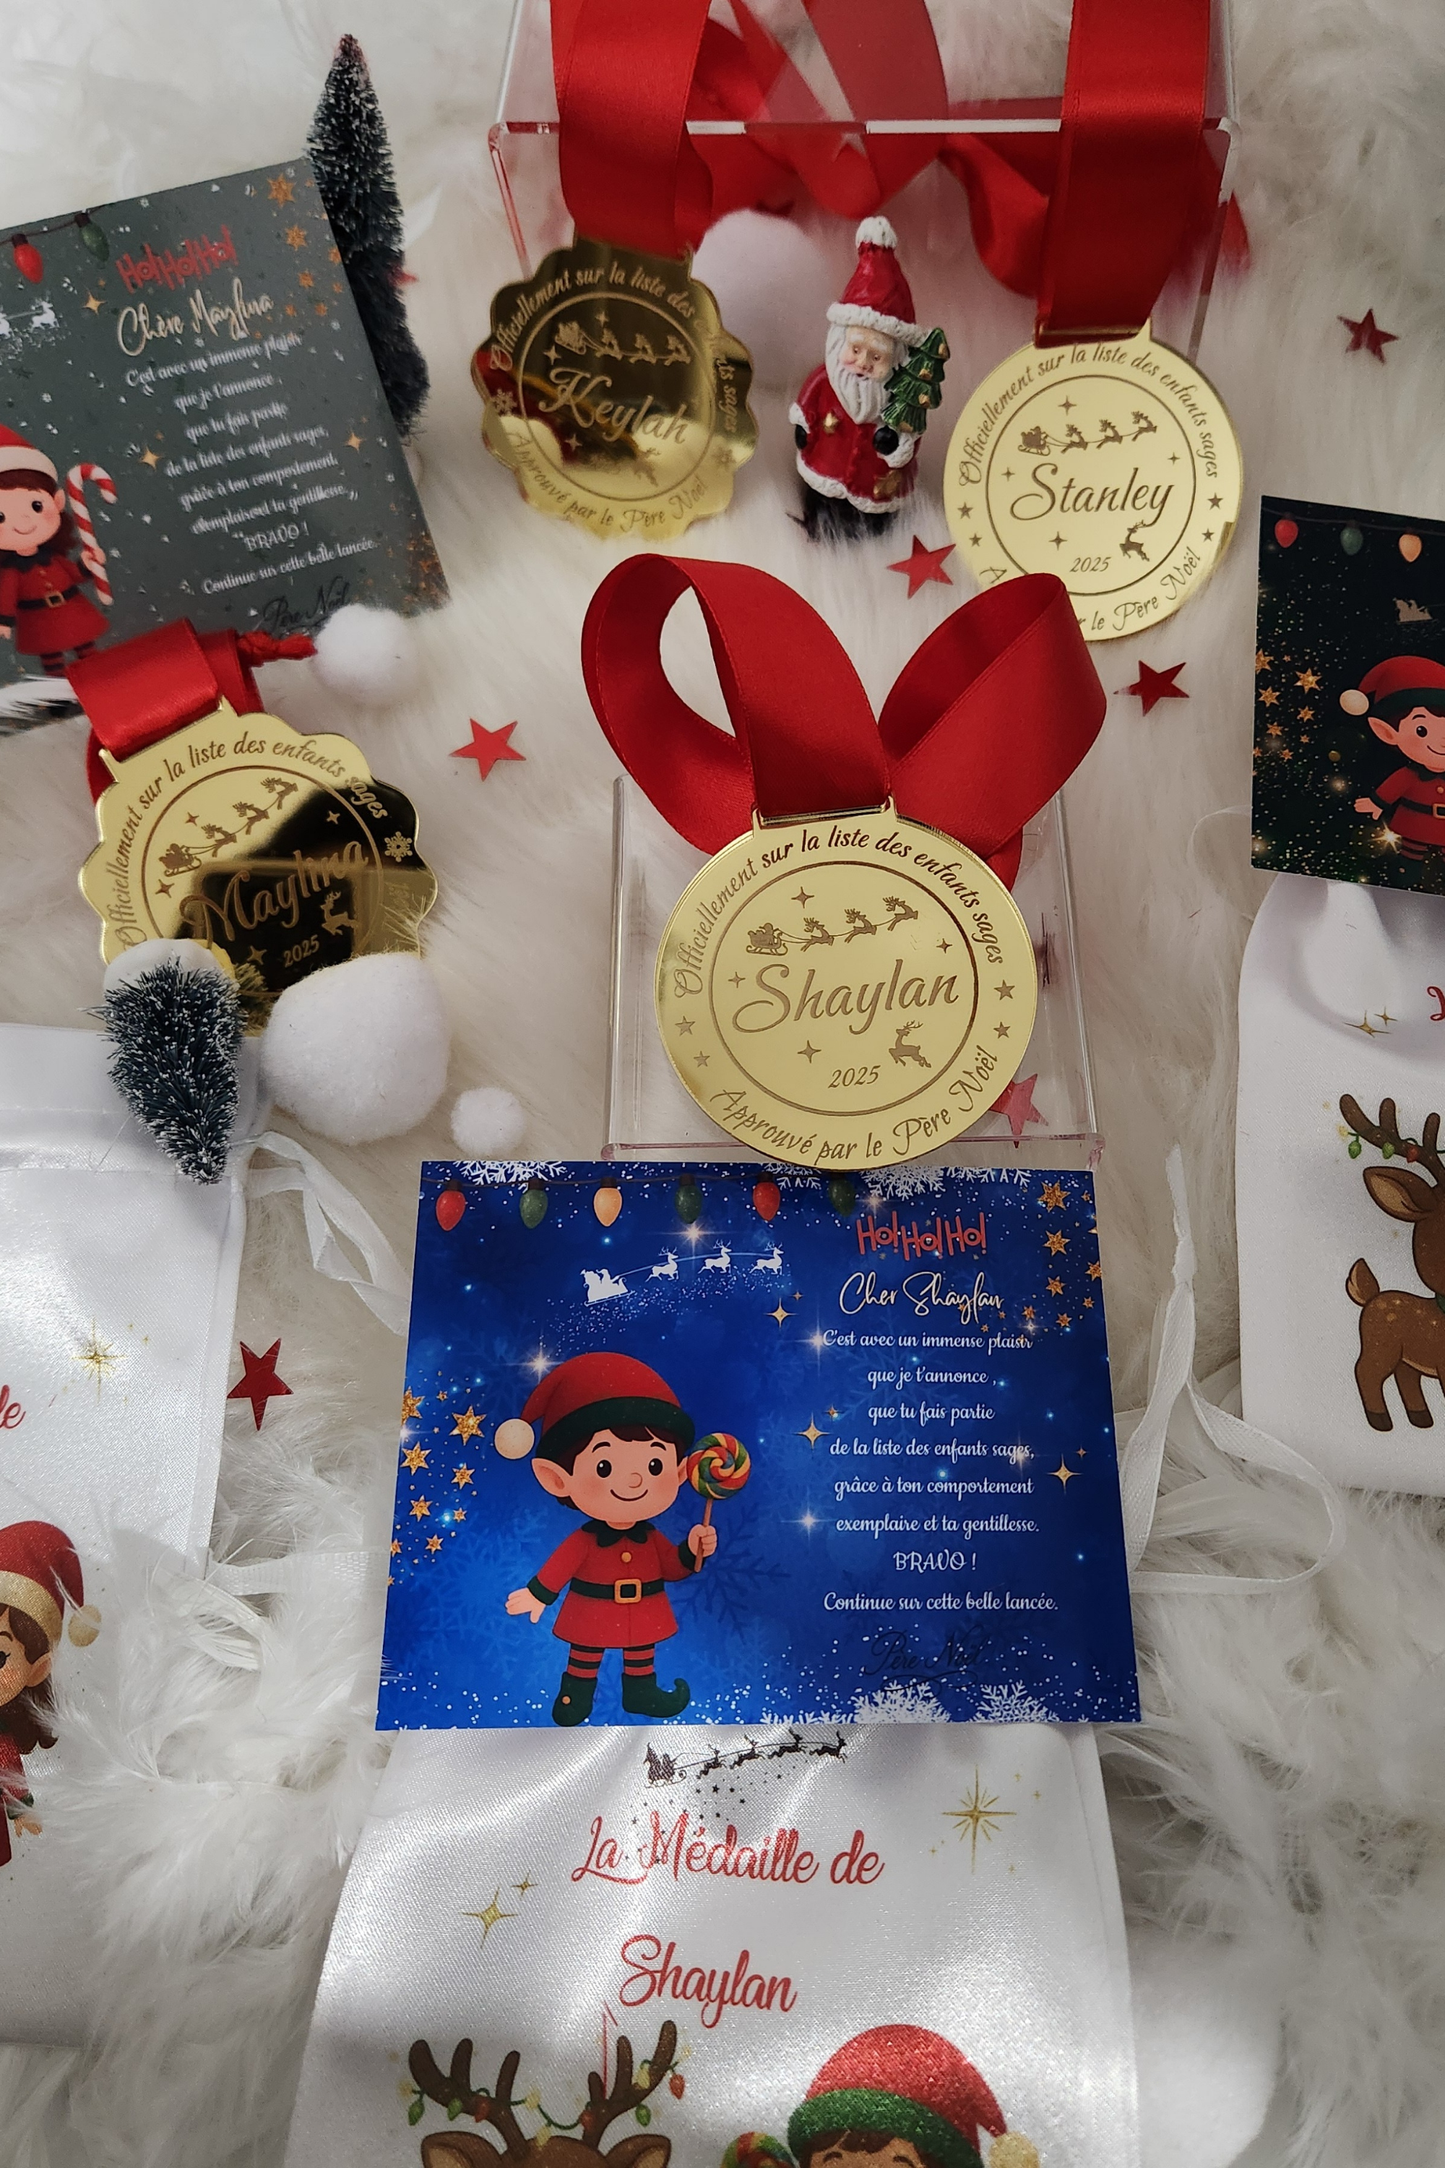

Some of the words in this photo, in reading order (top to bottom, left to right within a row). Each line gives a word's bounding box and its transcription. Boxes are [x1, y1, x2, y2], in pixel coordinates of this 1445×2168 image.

[489, 267, 573, 372] Officiellement
[576, 267, 604, 287] sur
[609, 261, 626, 285] la
[631, 263, 666, 296] liste
[667, 290, 696, 320] des
[719, 384, 737, 433] sages
[174, 394, 198, 415] que
[538, 367, 689, 445] Keylah
[958, 366, 1035, 487] Officiellement
[1038, 352, 1065, 377] sur
[1070, 343, 1087, 364] la
[1092, 345, 1127, 365] liste
[1131, 351, 1160, 378] des
[1159, 373, 1208, 428] enfants
[1196, 430, 1218, 479] sages
[185, 423, 210, 444] que
[1009, 462, 1175, 528] Stanley
[243, 523, 300, 552] BRAVO
[601, 507, 614, 527] le
[202, 570, 259, 595] Continue
[280, 556, 307, 574] cette
[306, 541, 336, 566] belle
[1069, 556, 1112, 573] 2025
[1091, 610, 1105, 632] le
[1112, 595, 1160, 632] Père
[1160, 546, 1202, 601] Noël
[105, 805, 149, 950] Officiellement
[140, 775, 172, 811] sur
[163, 758, 185, 783] la
[189, 741, 227, 770] liste
[233, 731, 266, 755] des
[272, 739, 346, 779] enfants
[344, 775, 389, 820] sages
[179, 840, 369, 950] Maylina
[673, 859, 757, 999] Officiellement
[761, 843, 795, 869] sur
[801, 829, 820, 853] la
[827, 824, 871, 850] liste
[875, 831, 913, 858] des
[913, 850, 980, 909] enfants
[971, 911, 1004, 965] sages
[282, 934, 321, 969] 2025
[731, 959, 960, 1036] Shaylan
[827, 1064, 882, 1090] 2025
[708, 1088, 819, 1156] Approuvé
[814, 1141, 859, 1166] par
[865, 1132, 882, 1158] le
[892, 1106, 952, 1156] Père
[948, 1044, 999, 1114] Noël
[839, 1271, 898, 1316] Cher
[902, 1271, 1004, 1325] Shaylan
[823, 1329, 857, 1347] C'est
[860, 1334, 896, 1348] avec
[898, 1334, 919, 1348] un
[922, 1333, 985, 1349] immense
[988, 1331, 1034, 1356] plaisir
[867, 1369, 896, 1390] que
[896, 1366, 914, 1391] je
[916, 1366, 990, 1384] t'annonce
[868, 1405, 898, 1427] que
[900, 1401, 917, 1420] tu
[919, 1400, 948, 1427] fais
[950, 1402, 996, 1427] partie
[829, 1437, 850, 1456] de
[853, 1437, 871, 1456] la
[873, 1437, 902, 1456] liste
[906, 1438, 930, 1456] des
[934, 1438, 989, 1465] enfants
[991, 1442, 1036, 1466] sages,
[834, 1475, 879, 1502] grâce
[882, 1475, 895, 1494] à
[897, 1475, 923, 1494] ton
[926, 1476, 1035, 1502] comportement
[836, 1513, 921, 1540] exemplaire
[923, 1513, 939, 1532] et
[942, 1514, 960, 1533] ta
[962, 1513, 1040, 1541] gentillesse.
[893, 1548, 967, 1574] BRAVO
[823, 1591, 896, 1611] Continue
[898, 1596, 924, 1611] sur
[926, 1591, 963, 1611] cette
[965, 1591, 1002, 1611] belle
[1005, 1592, 1060, 1611] lancée.
[864, 1628, 919, 1676] Père
[571, 1815, 648, 1885] La
[639, 1810, 821, 1884] Médaille
[830, 1829, 886, 1885] de
[619, 1933, 798, 2029] Shaylan
